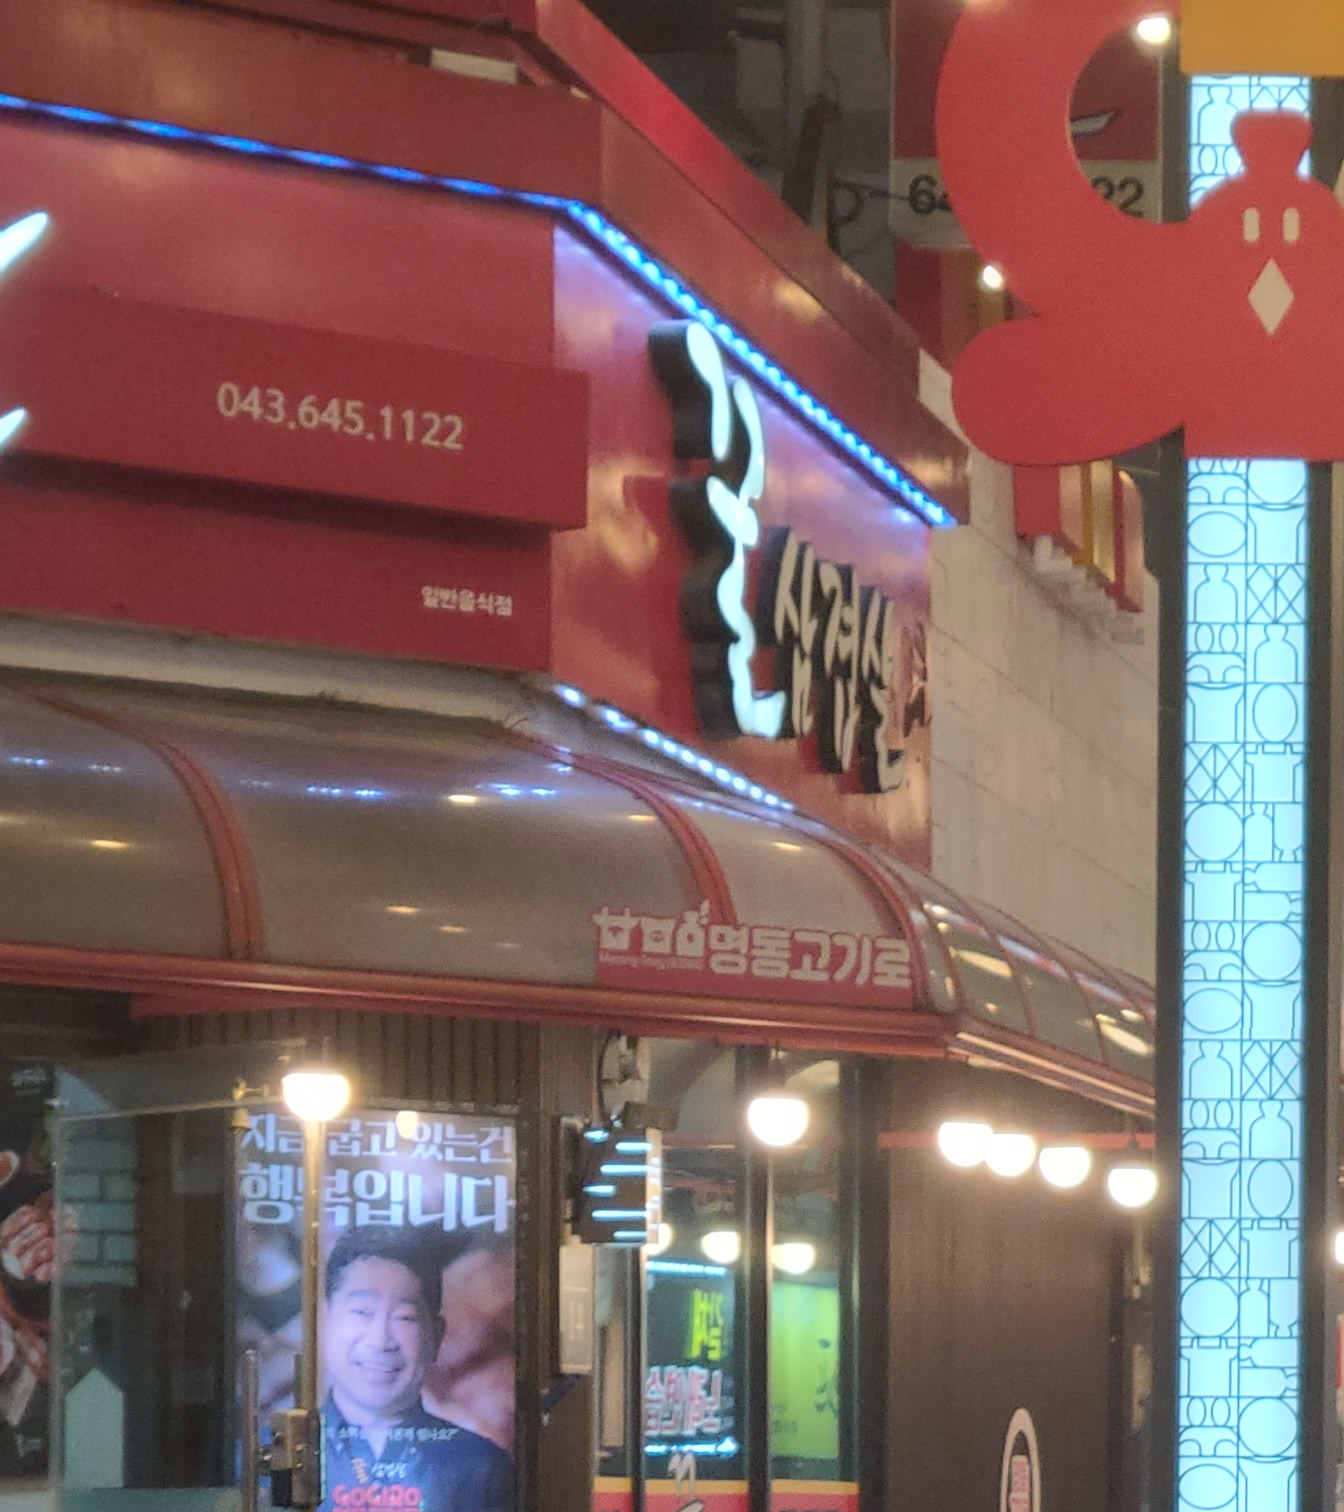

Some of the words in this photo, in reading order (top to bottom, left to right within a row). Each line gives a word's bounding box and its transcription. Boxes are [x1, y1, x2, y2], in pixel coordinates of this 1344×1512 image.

[215, 381, 466, 452] 043.645.1122
[420, 584, 514, 618] 일반음식점
[773, 524, 906, 794] 삼겹살
[708, 923, 912, 988] 명동고기로
